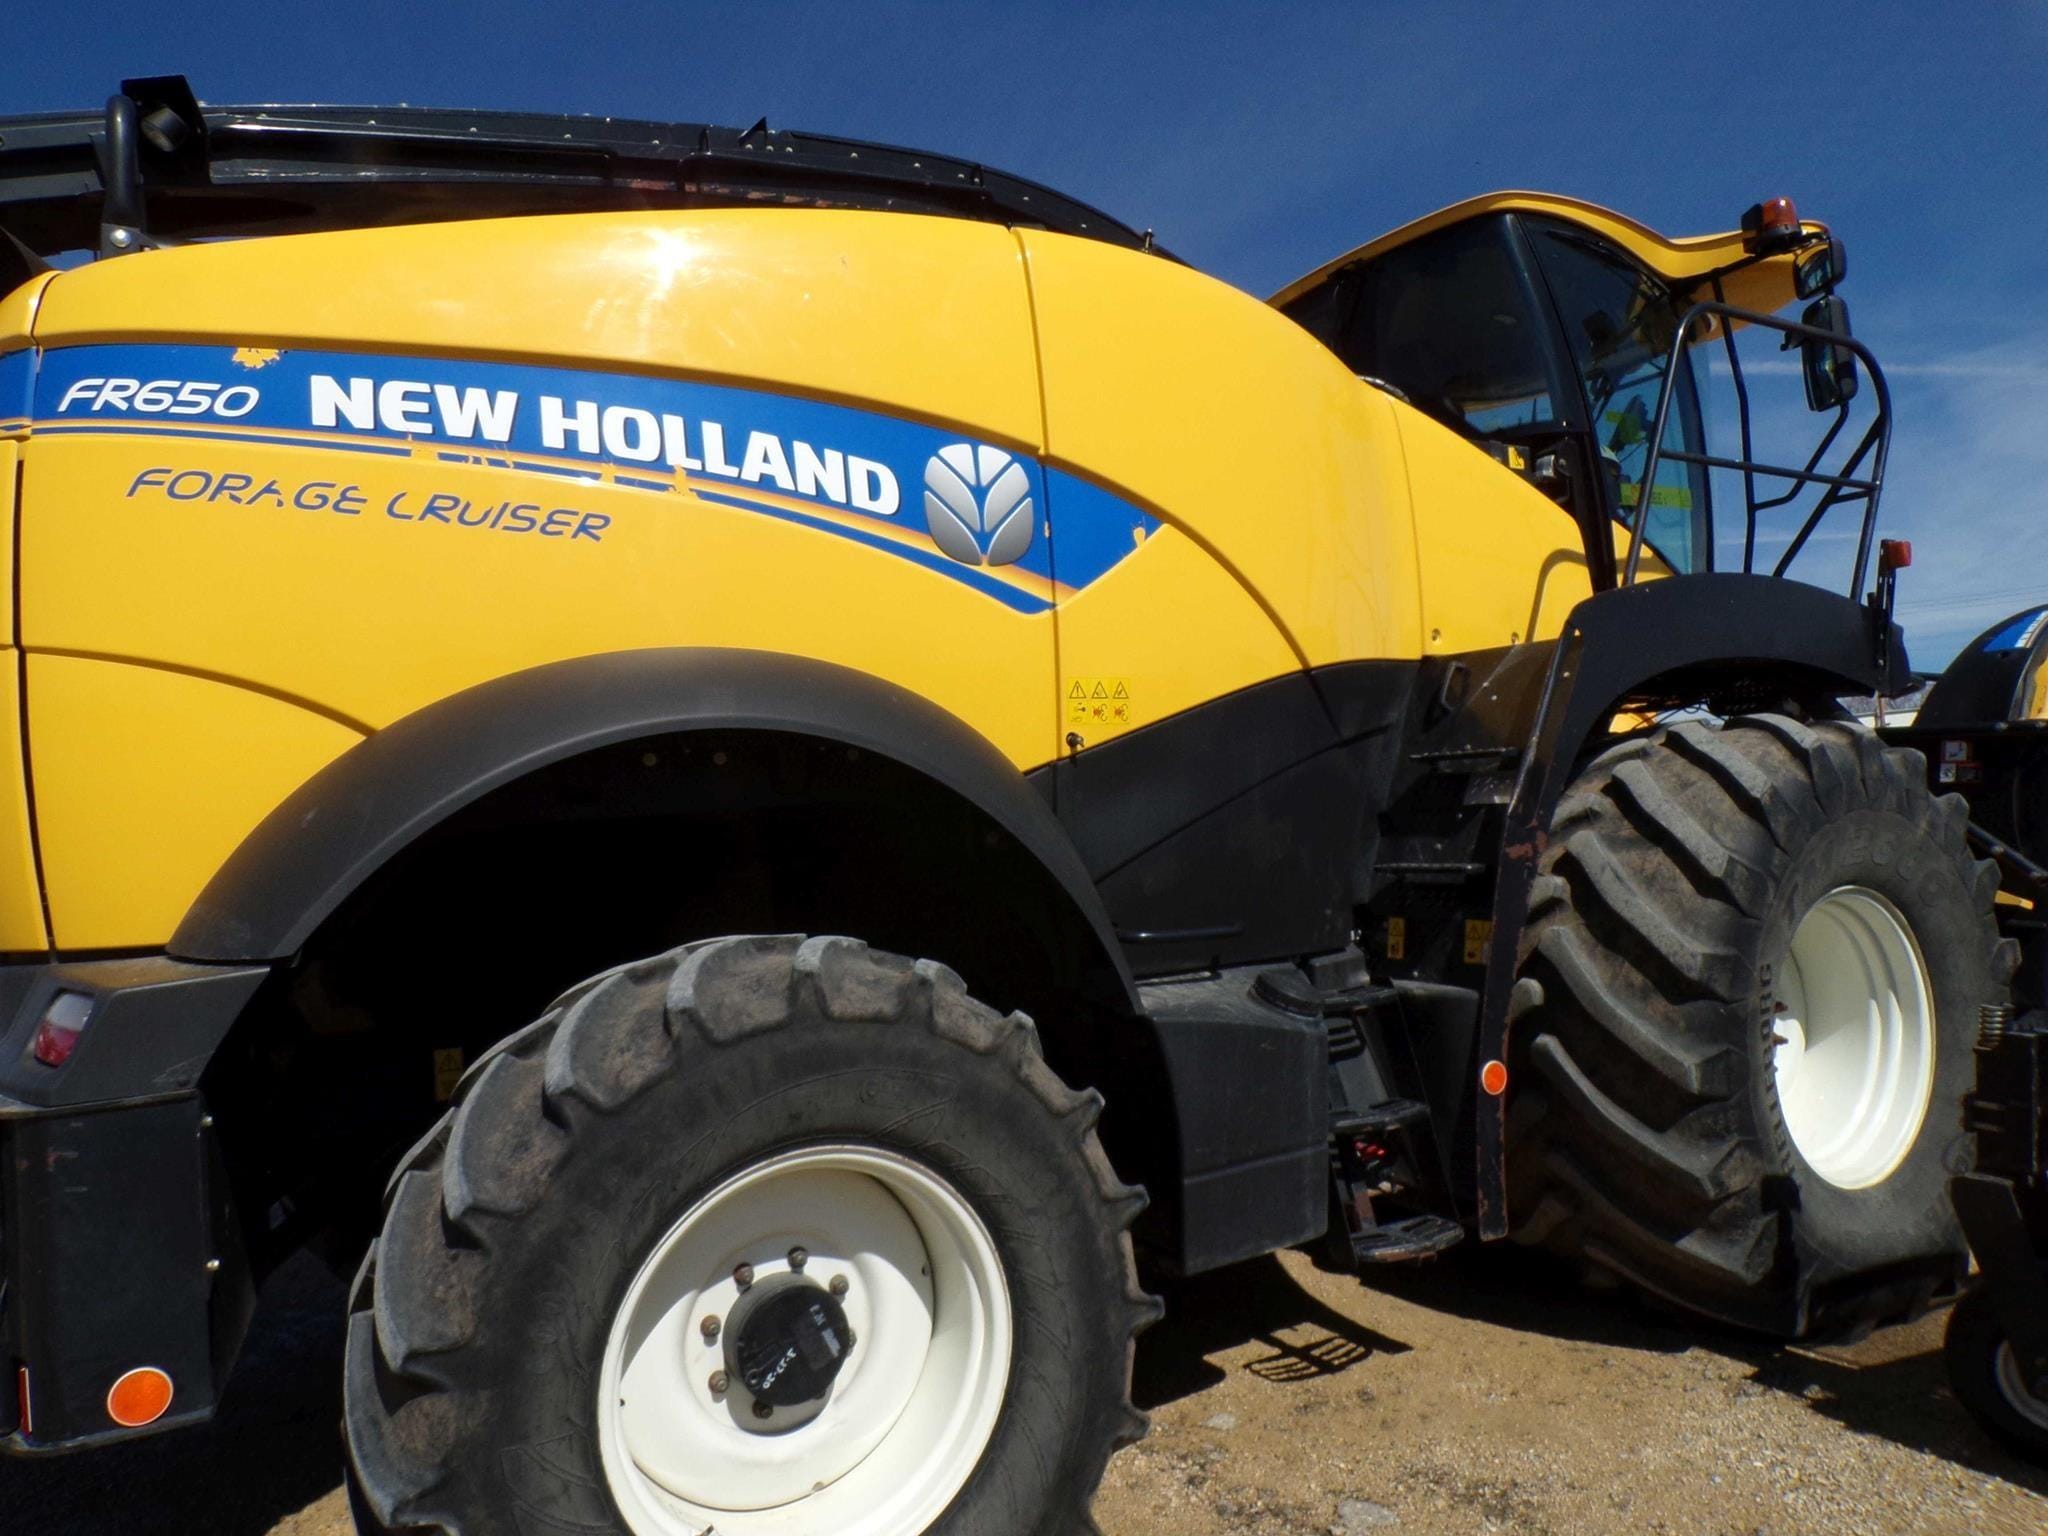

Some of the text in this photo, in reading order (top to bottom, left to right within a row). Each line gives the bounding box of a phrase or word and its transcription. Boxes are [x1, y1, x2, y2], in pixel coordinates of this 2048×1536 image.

[58, 378, 260, 417] FR650
[310, 375, 900, 515] NEW HOLLAND
[126, 468, 611, 542] FORAGE CRUISER
